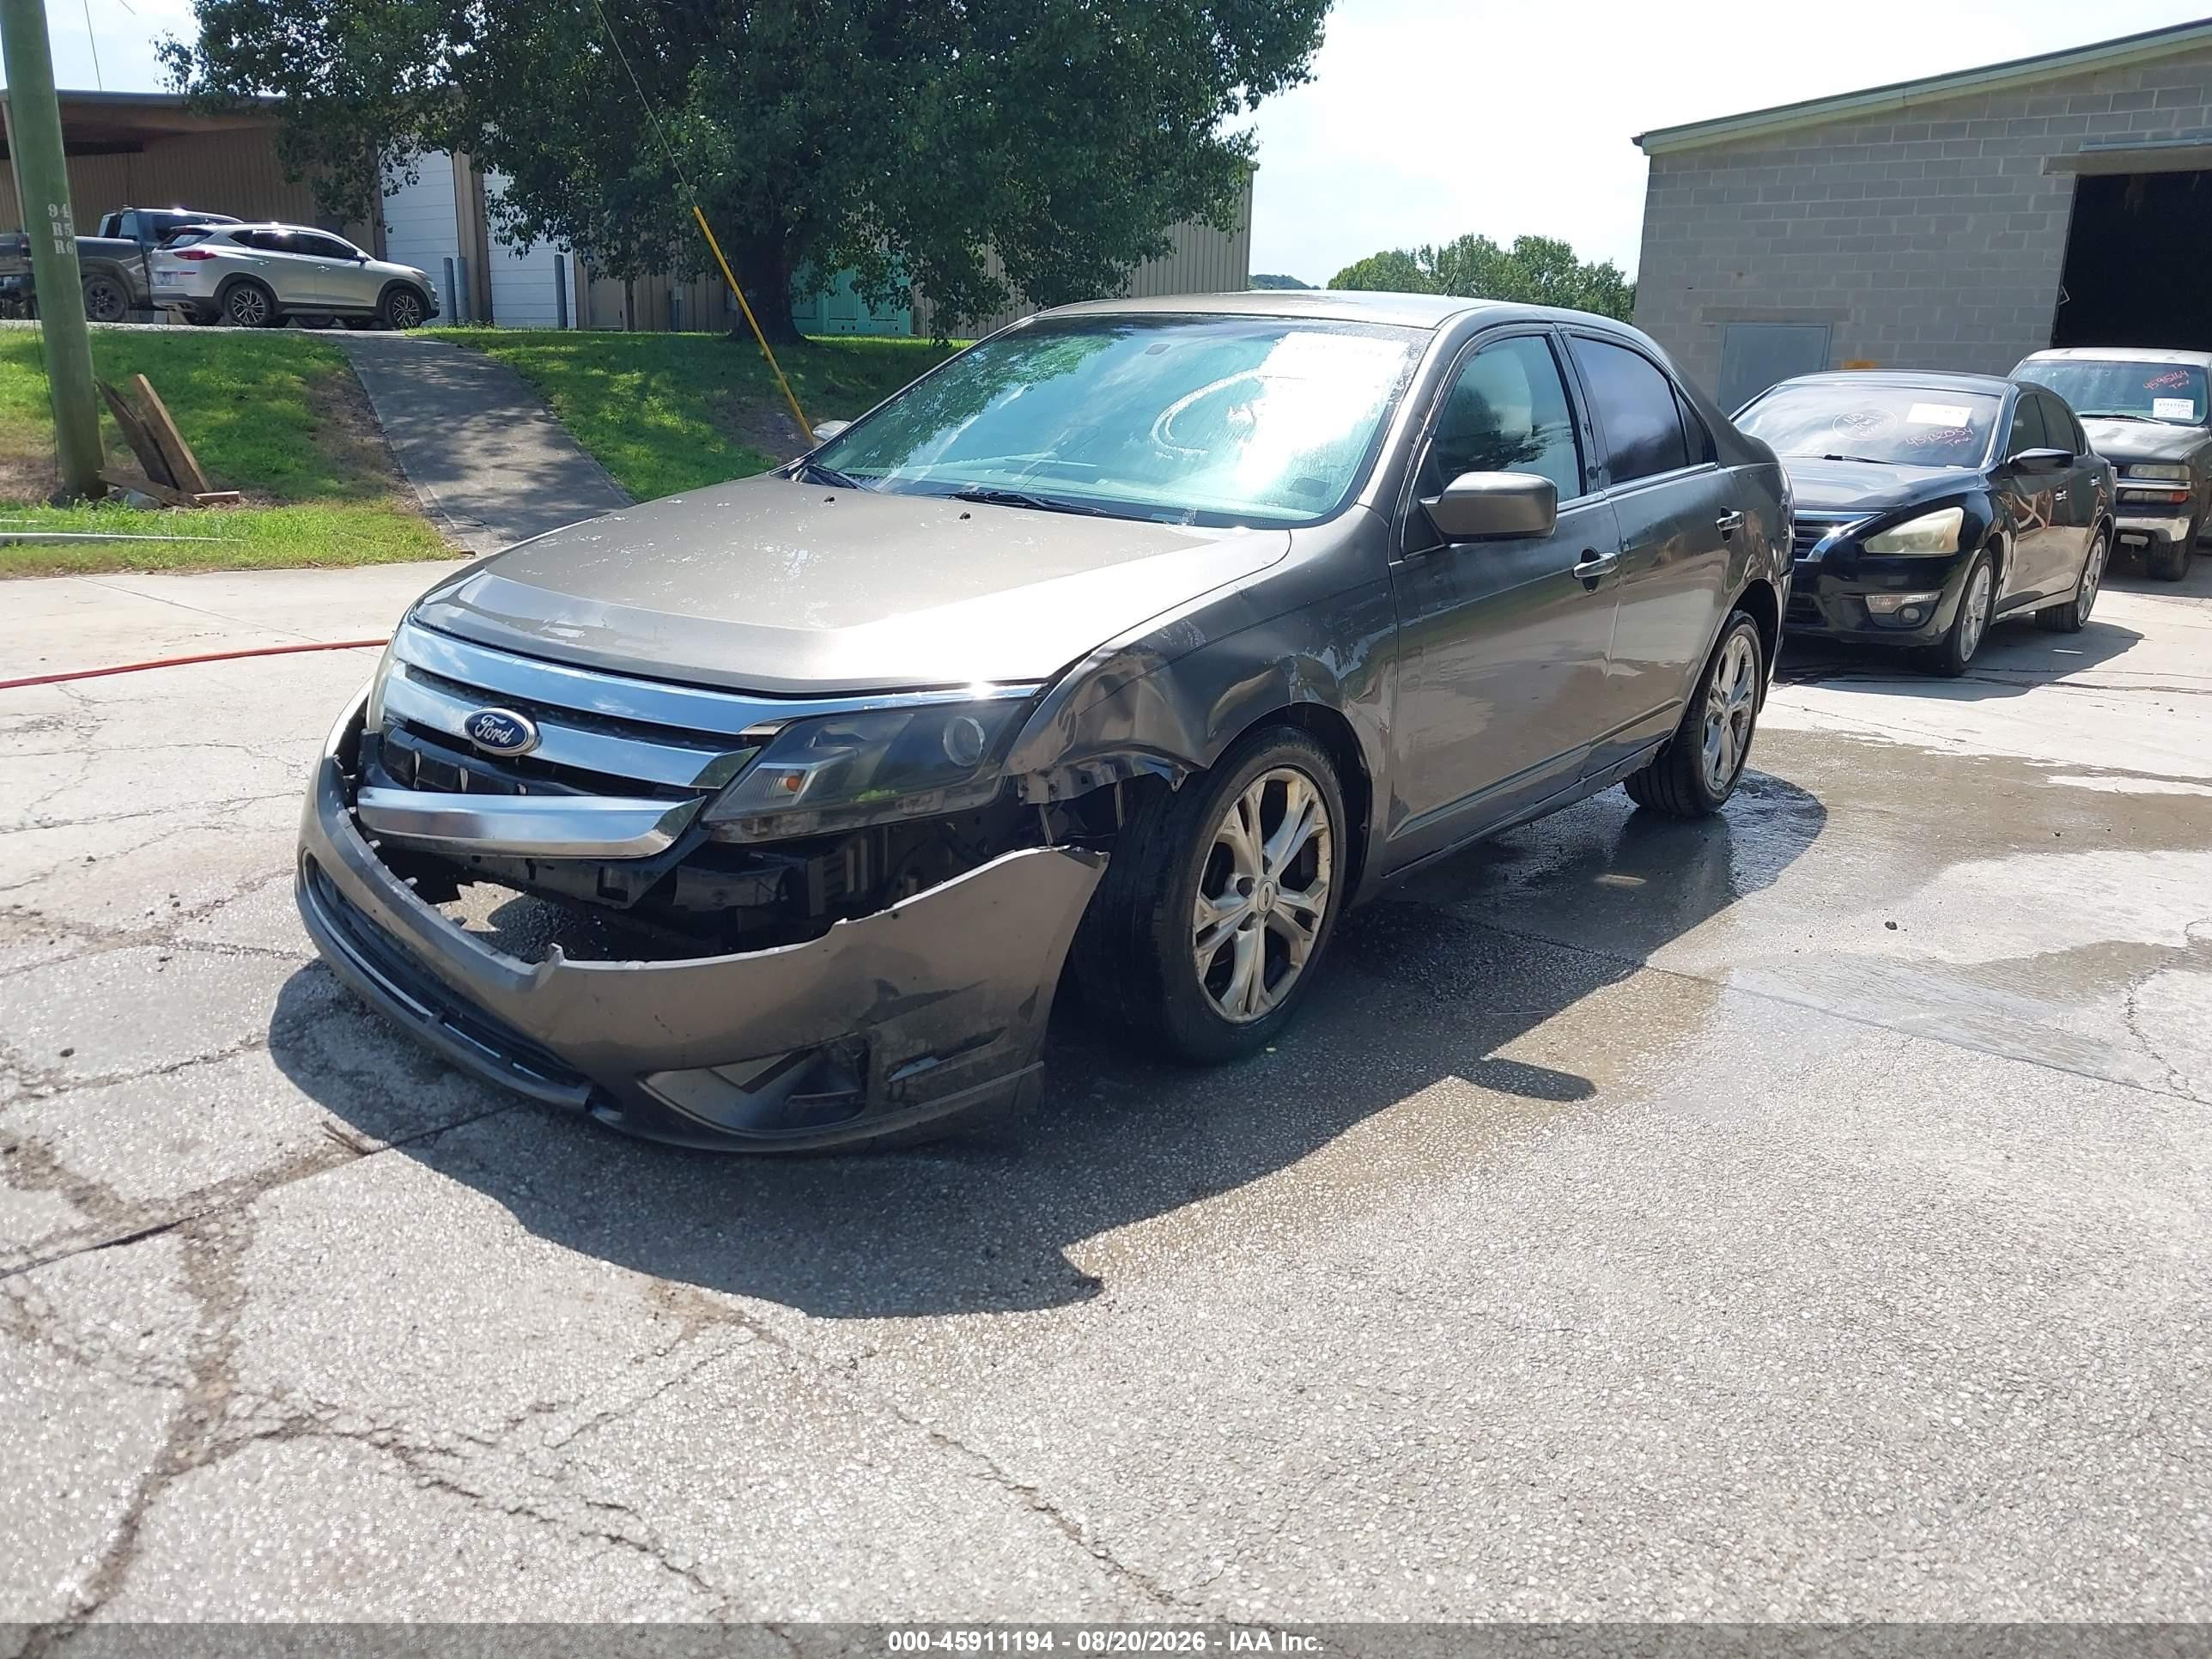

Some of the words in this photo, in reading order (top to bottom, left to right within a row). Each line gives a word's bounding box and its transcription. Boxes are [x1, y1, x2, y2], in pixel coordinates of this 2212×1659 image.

[47, 203, 70, 218] 94
[52, 222, 72, 237] R5
[54, 240, 74, 255] R6
[474, 714, 515, 744] Ford
